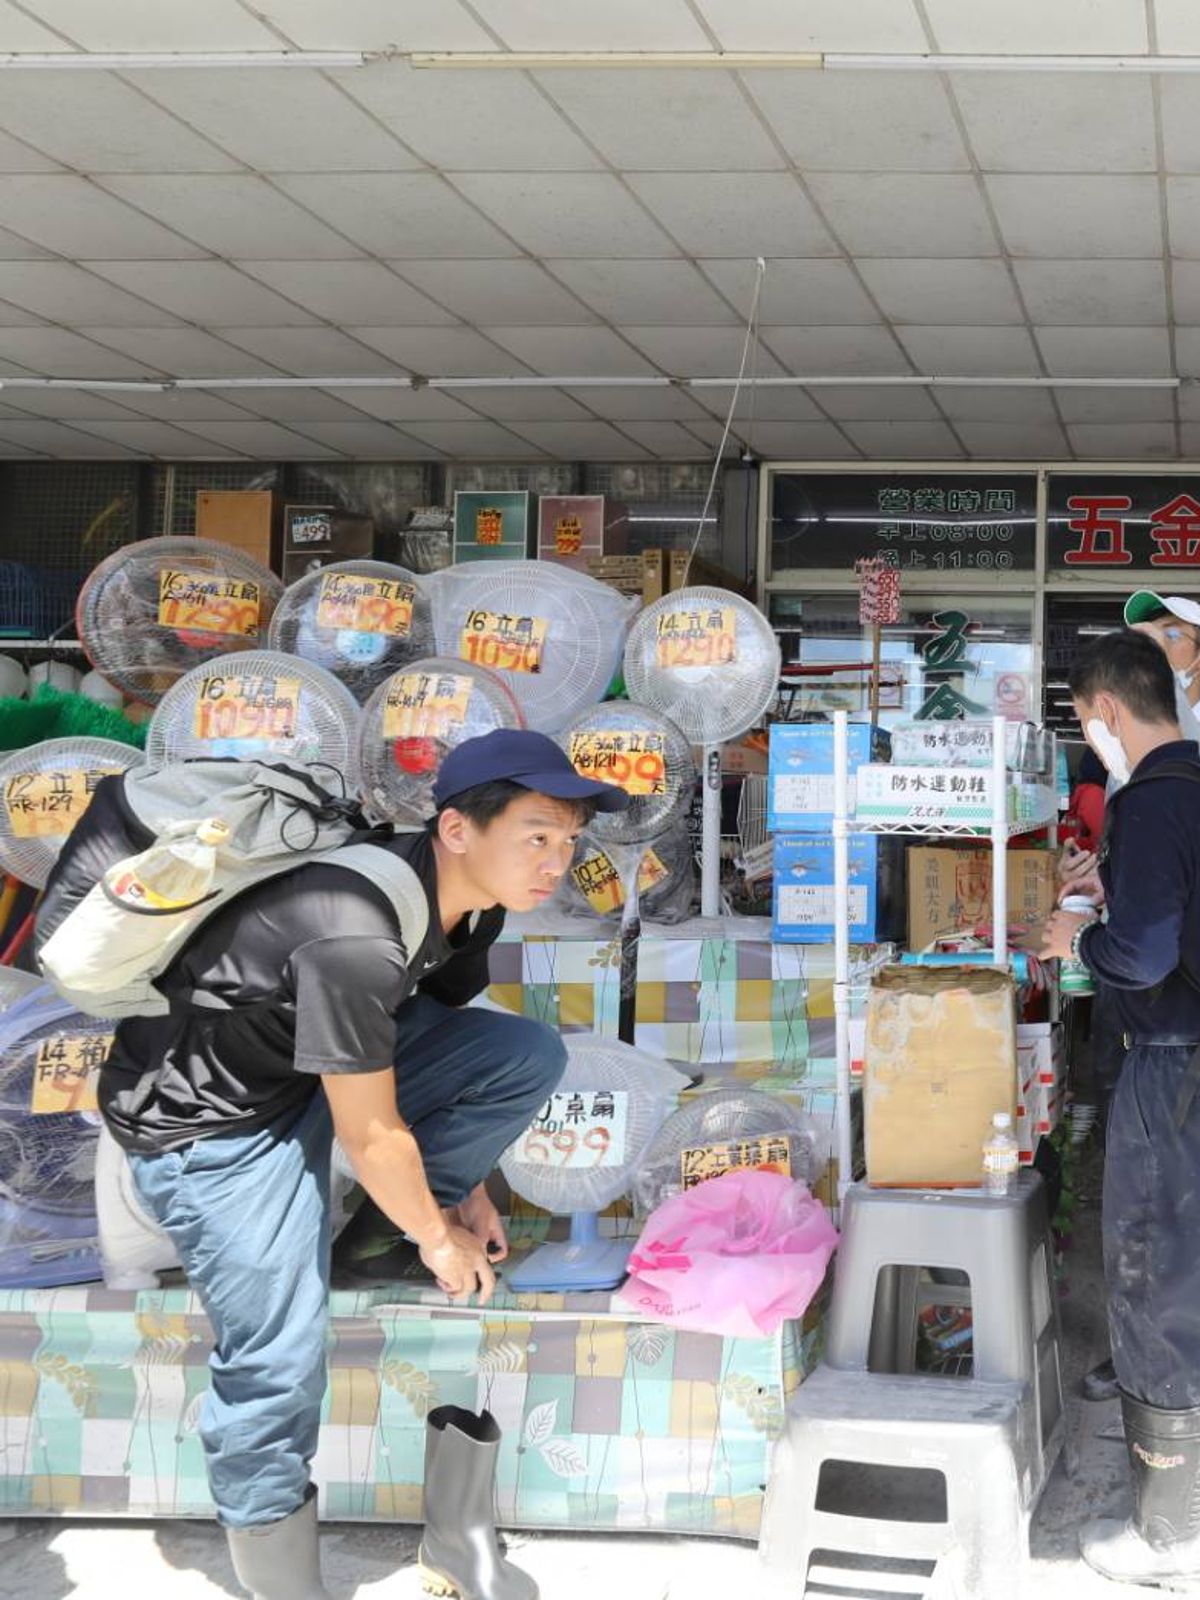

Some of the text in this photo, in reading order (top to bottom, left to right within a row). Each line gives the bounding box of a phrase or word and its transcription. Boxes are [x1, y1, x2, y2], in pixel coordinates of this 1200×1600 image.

[879, 488, 1015, 513] 營業時間
[922, 732, 993, 748] 防水運動
[890, 774, 987, 794] 防水運動鞋
